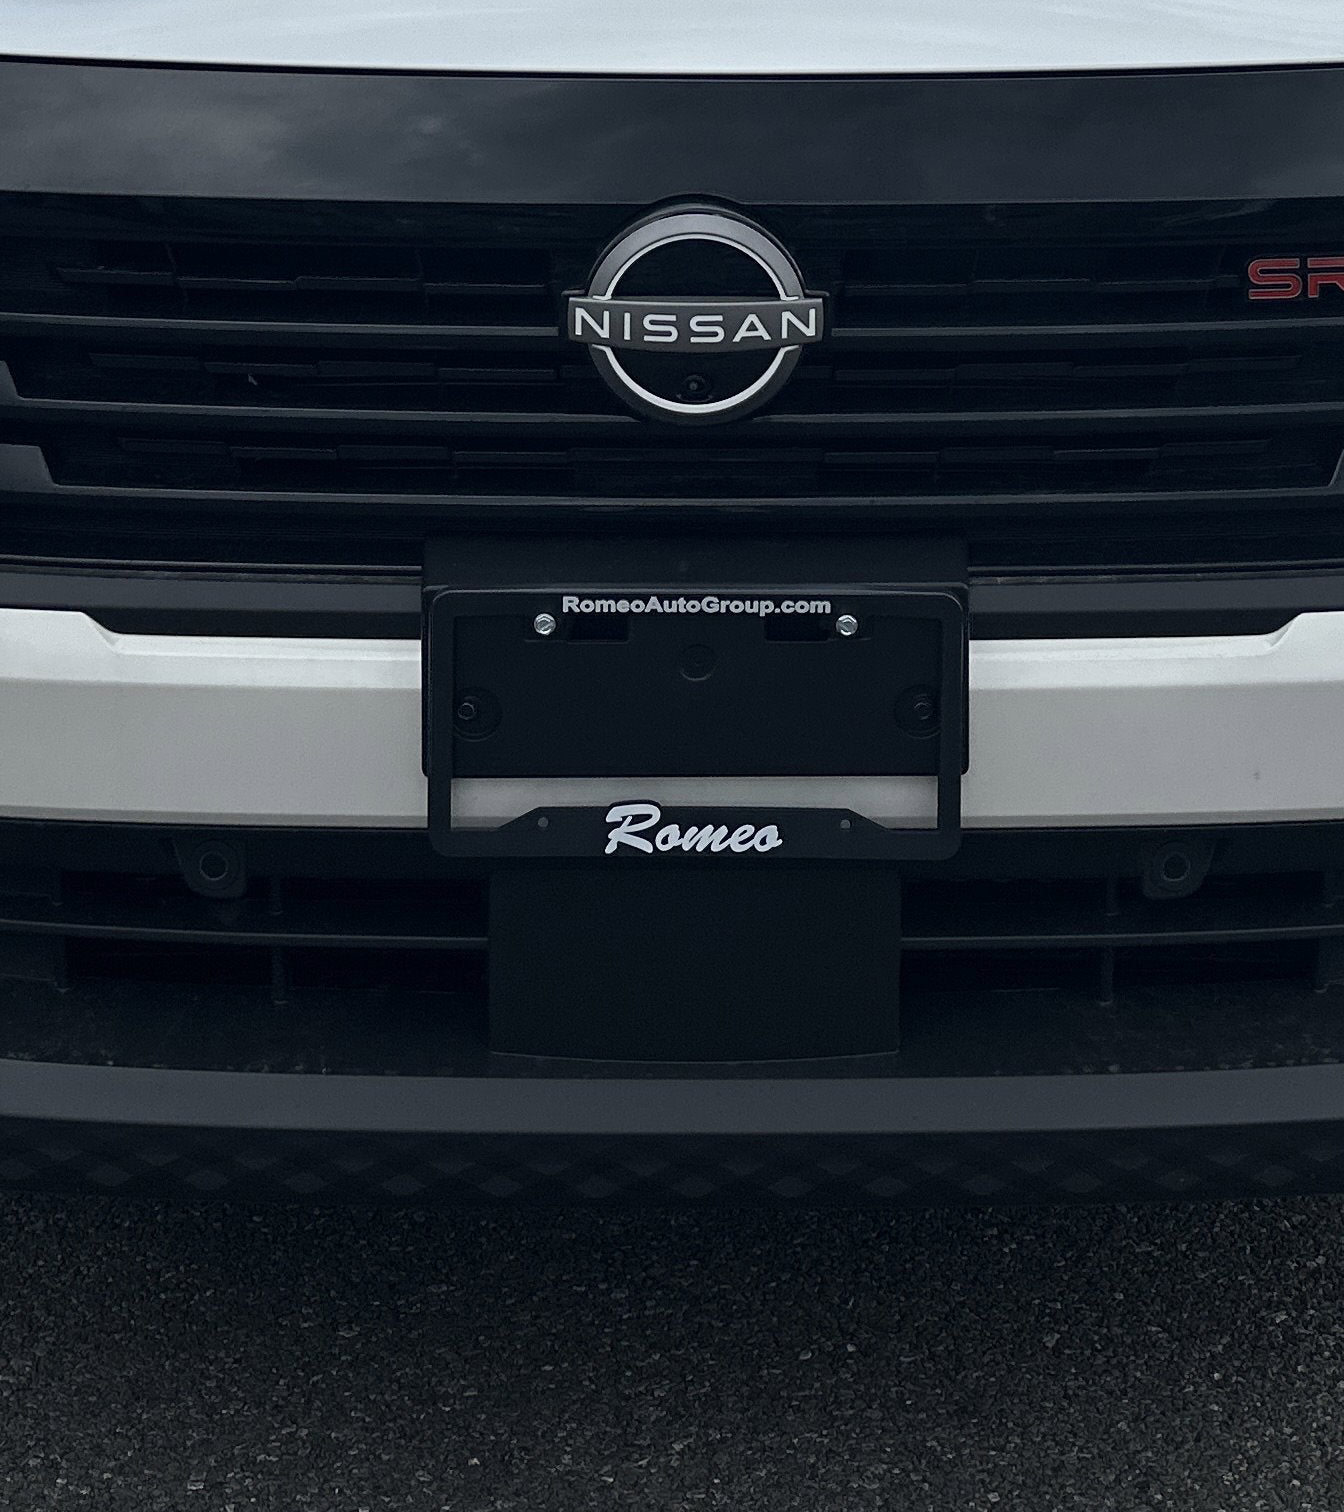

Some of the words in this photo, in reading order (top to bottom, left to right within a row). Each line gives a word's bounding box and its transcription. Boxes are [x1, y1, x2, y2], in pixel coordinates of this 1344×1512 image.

[574, 307, 816, 343] NISSAN
[562, 595, 832, 617] RomeoAutoGroup.com
[604, 803, 783, 855] Romeo
